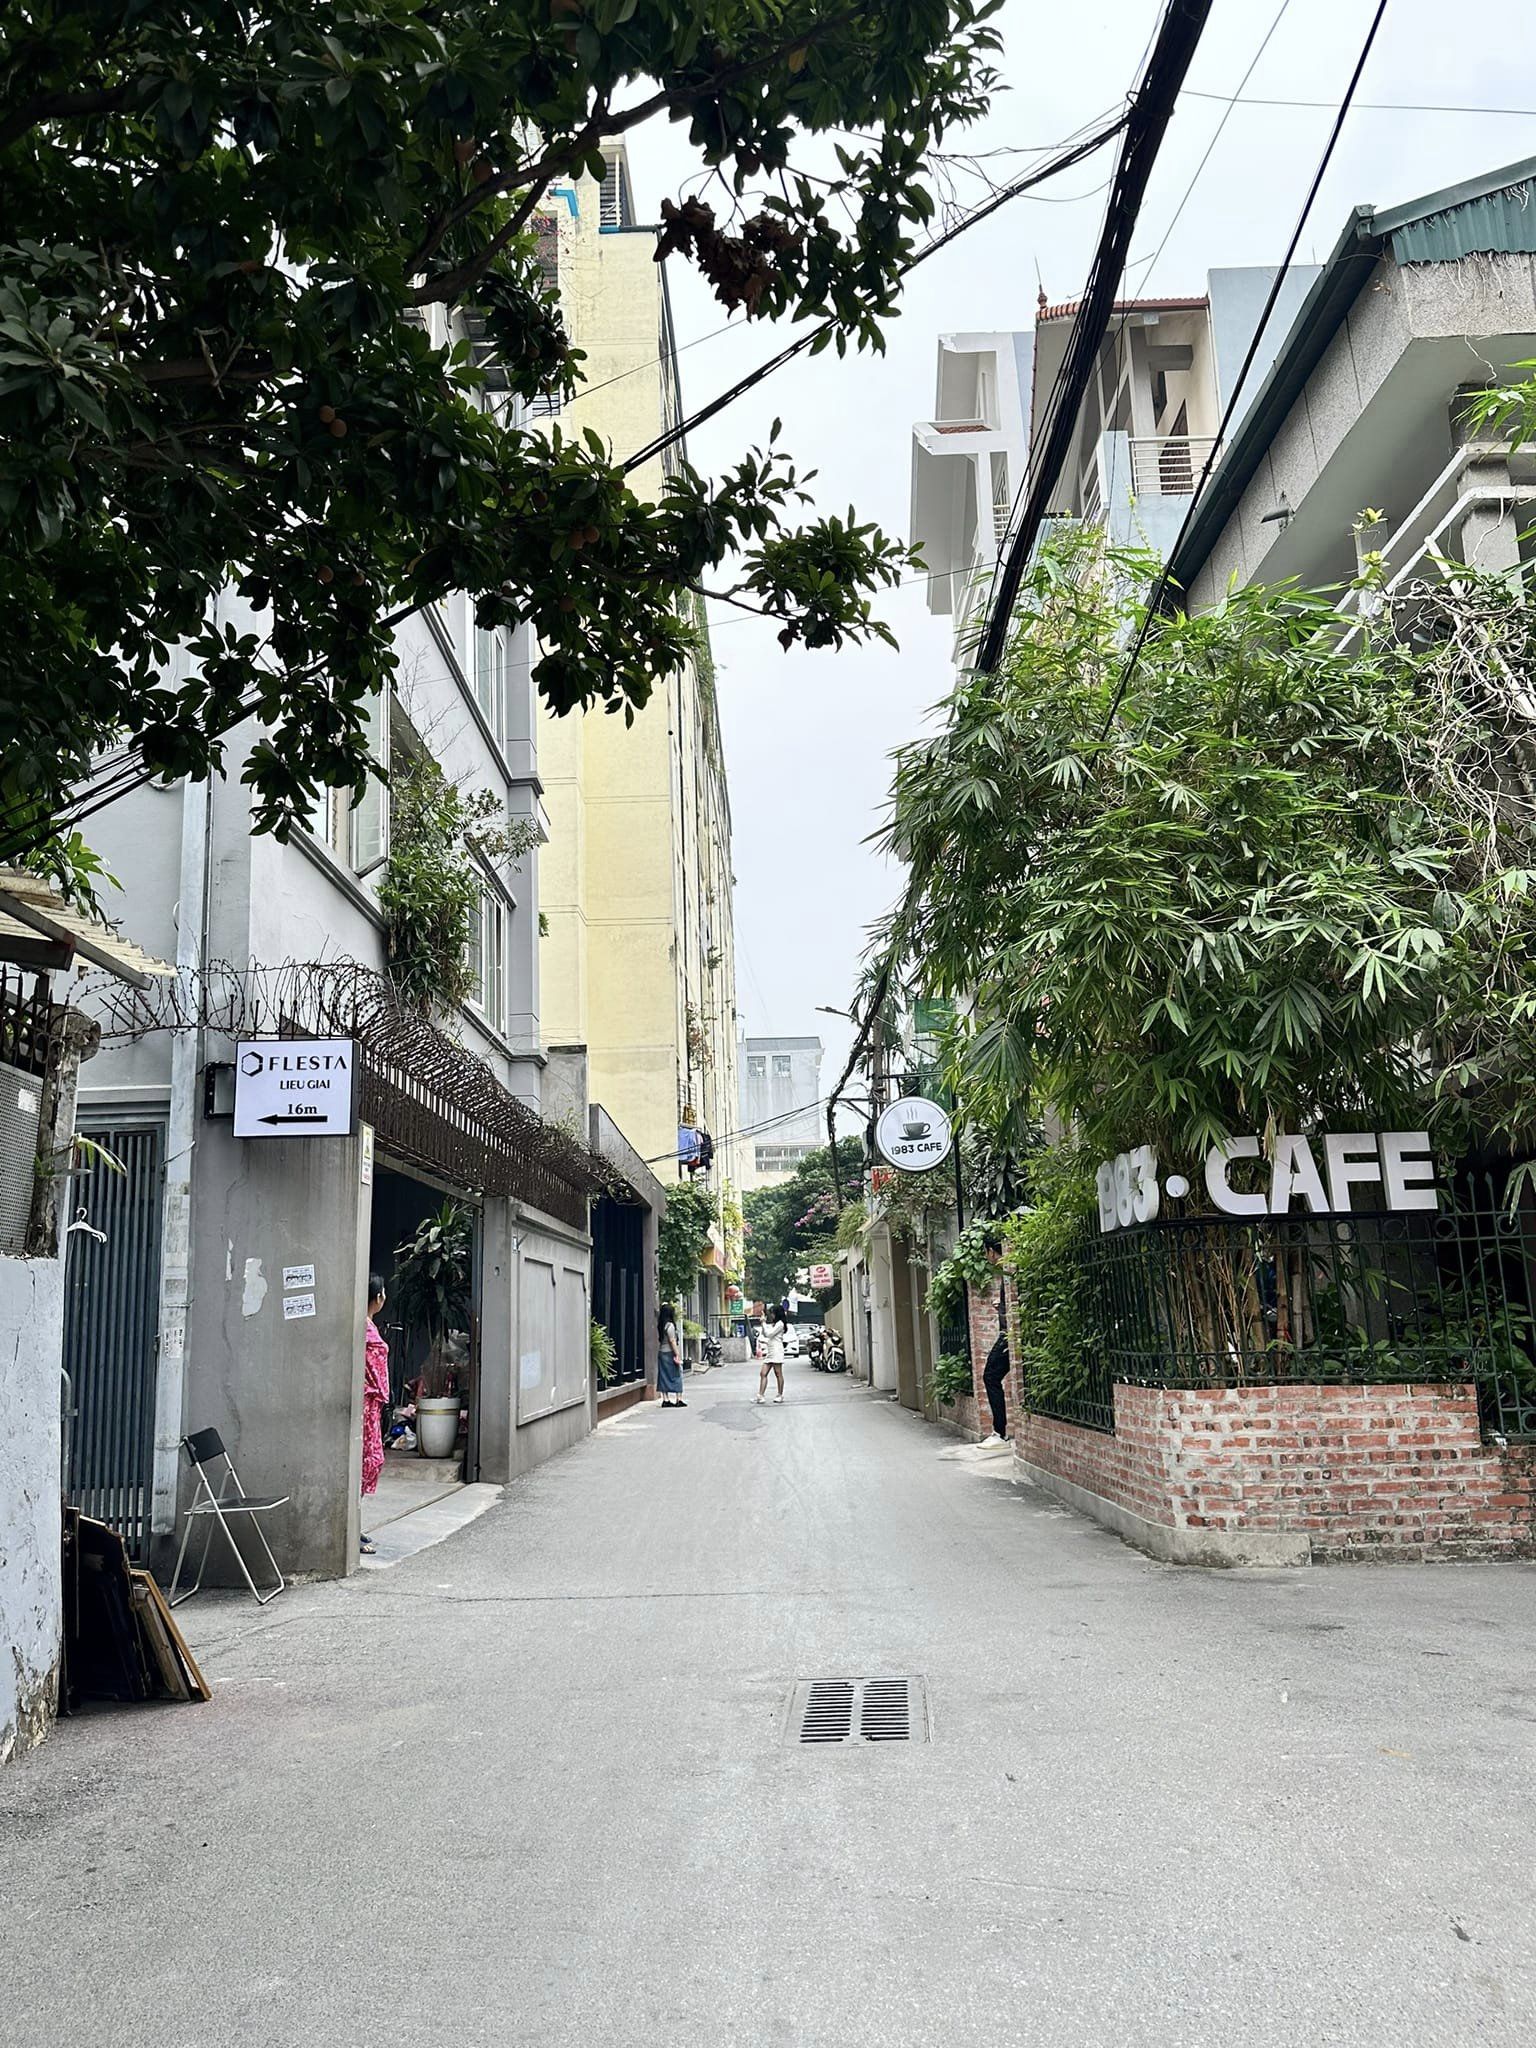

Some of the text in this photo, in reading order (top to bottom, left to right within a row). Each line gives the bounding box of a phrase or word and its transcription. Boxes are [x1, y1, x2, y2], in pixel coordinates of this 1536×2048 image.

[269, 1055, 347, 1071] FLESTA
[280, 1079, 330, 1090] LIEU GIAI
[287, 1103, 318, 1115] 16m
[891, 1142, 942, 1155] 1983 CAFE
[1205, 1131, 1438, 1216] CAFE
